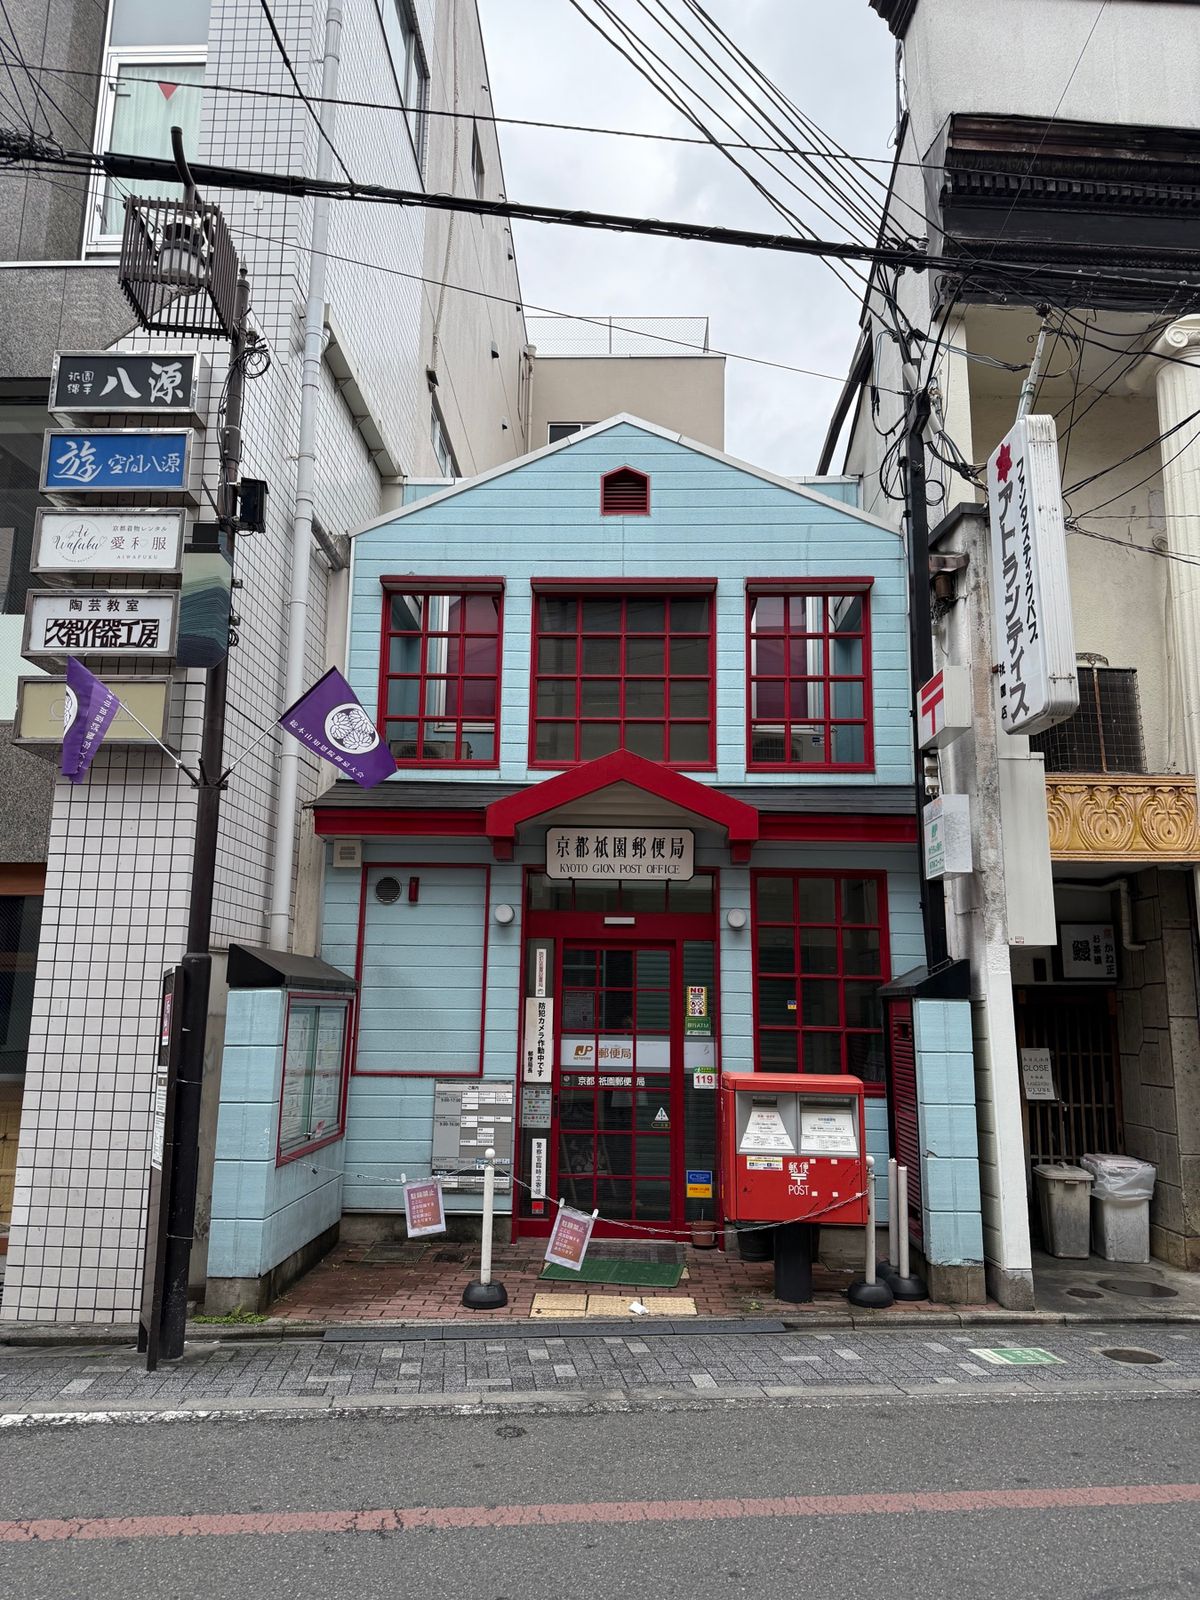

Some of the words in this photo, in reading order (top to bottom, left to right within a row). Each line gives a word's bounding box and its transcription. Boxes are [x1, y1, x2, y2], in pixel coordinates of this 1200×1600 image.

[99, 361, 184, 405] 八源
[53, 440, 103, 483] 遊
[107, 452, 180, 475] 空間八源
[1016, 456, 1038, 644] ファンタスティックパブ
[69, 598, 139, 613] 陶芸教室
[998, 480, 1029, 724] アトランティス
[555, 835, 685, 859] 京都祇園郵便局
[559, 863, 588, 873] KYOTO
[592, 863, 616, 873] GION
[619, 864, 643, 874] POST
[646, 864, 680, 875] OFFICE
[537, 1002, 546, 1077] 防犯カメラ作動中です
[598, 1047, 632, 1060] 郵便局
[1023, 1064, 1049, 1073] CLOSE
[696, 1075, 713, 1084] 119
[788, 1161, 809, 1175] 郵便
[788, 1185, 810, 1196] POST
